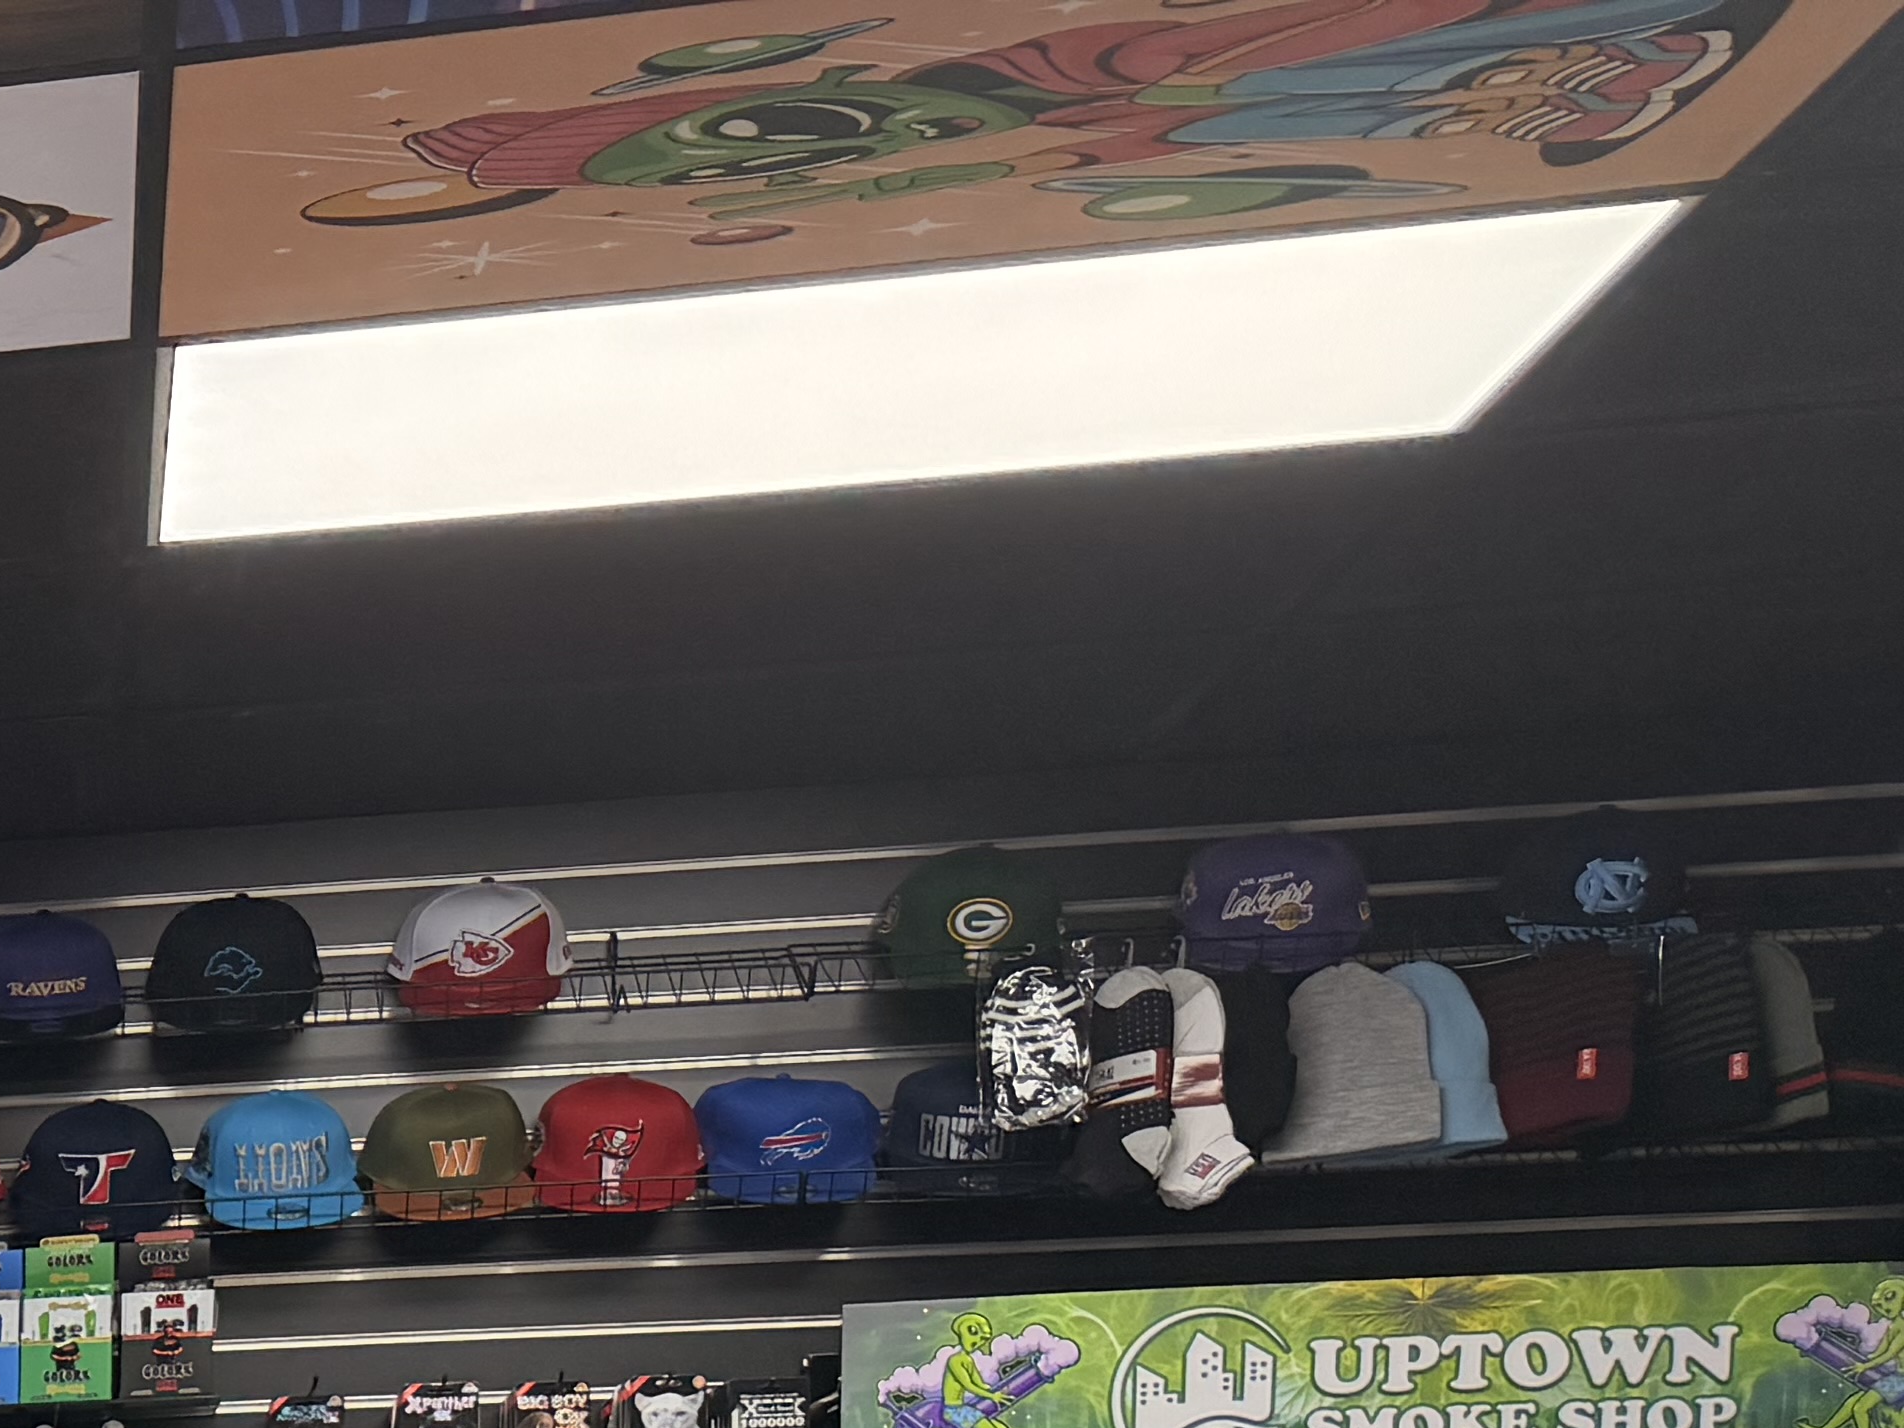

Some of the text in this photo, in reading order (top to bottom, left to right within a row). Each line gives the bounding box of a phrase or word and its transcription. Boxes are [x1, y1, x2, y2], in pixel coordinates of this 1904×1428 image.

[1222, 880, 1312, 920] Lakers
[8, 977, 87, 998] RAVENS
[234, 1133, 330, 1191] LIONS
[156, 1294, 184, 1307] ONE
[1308, 1322, 1743, 1397] UPTOWN
